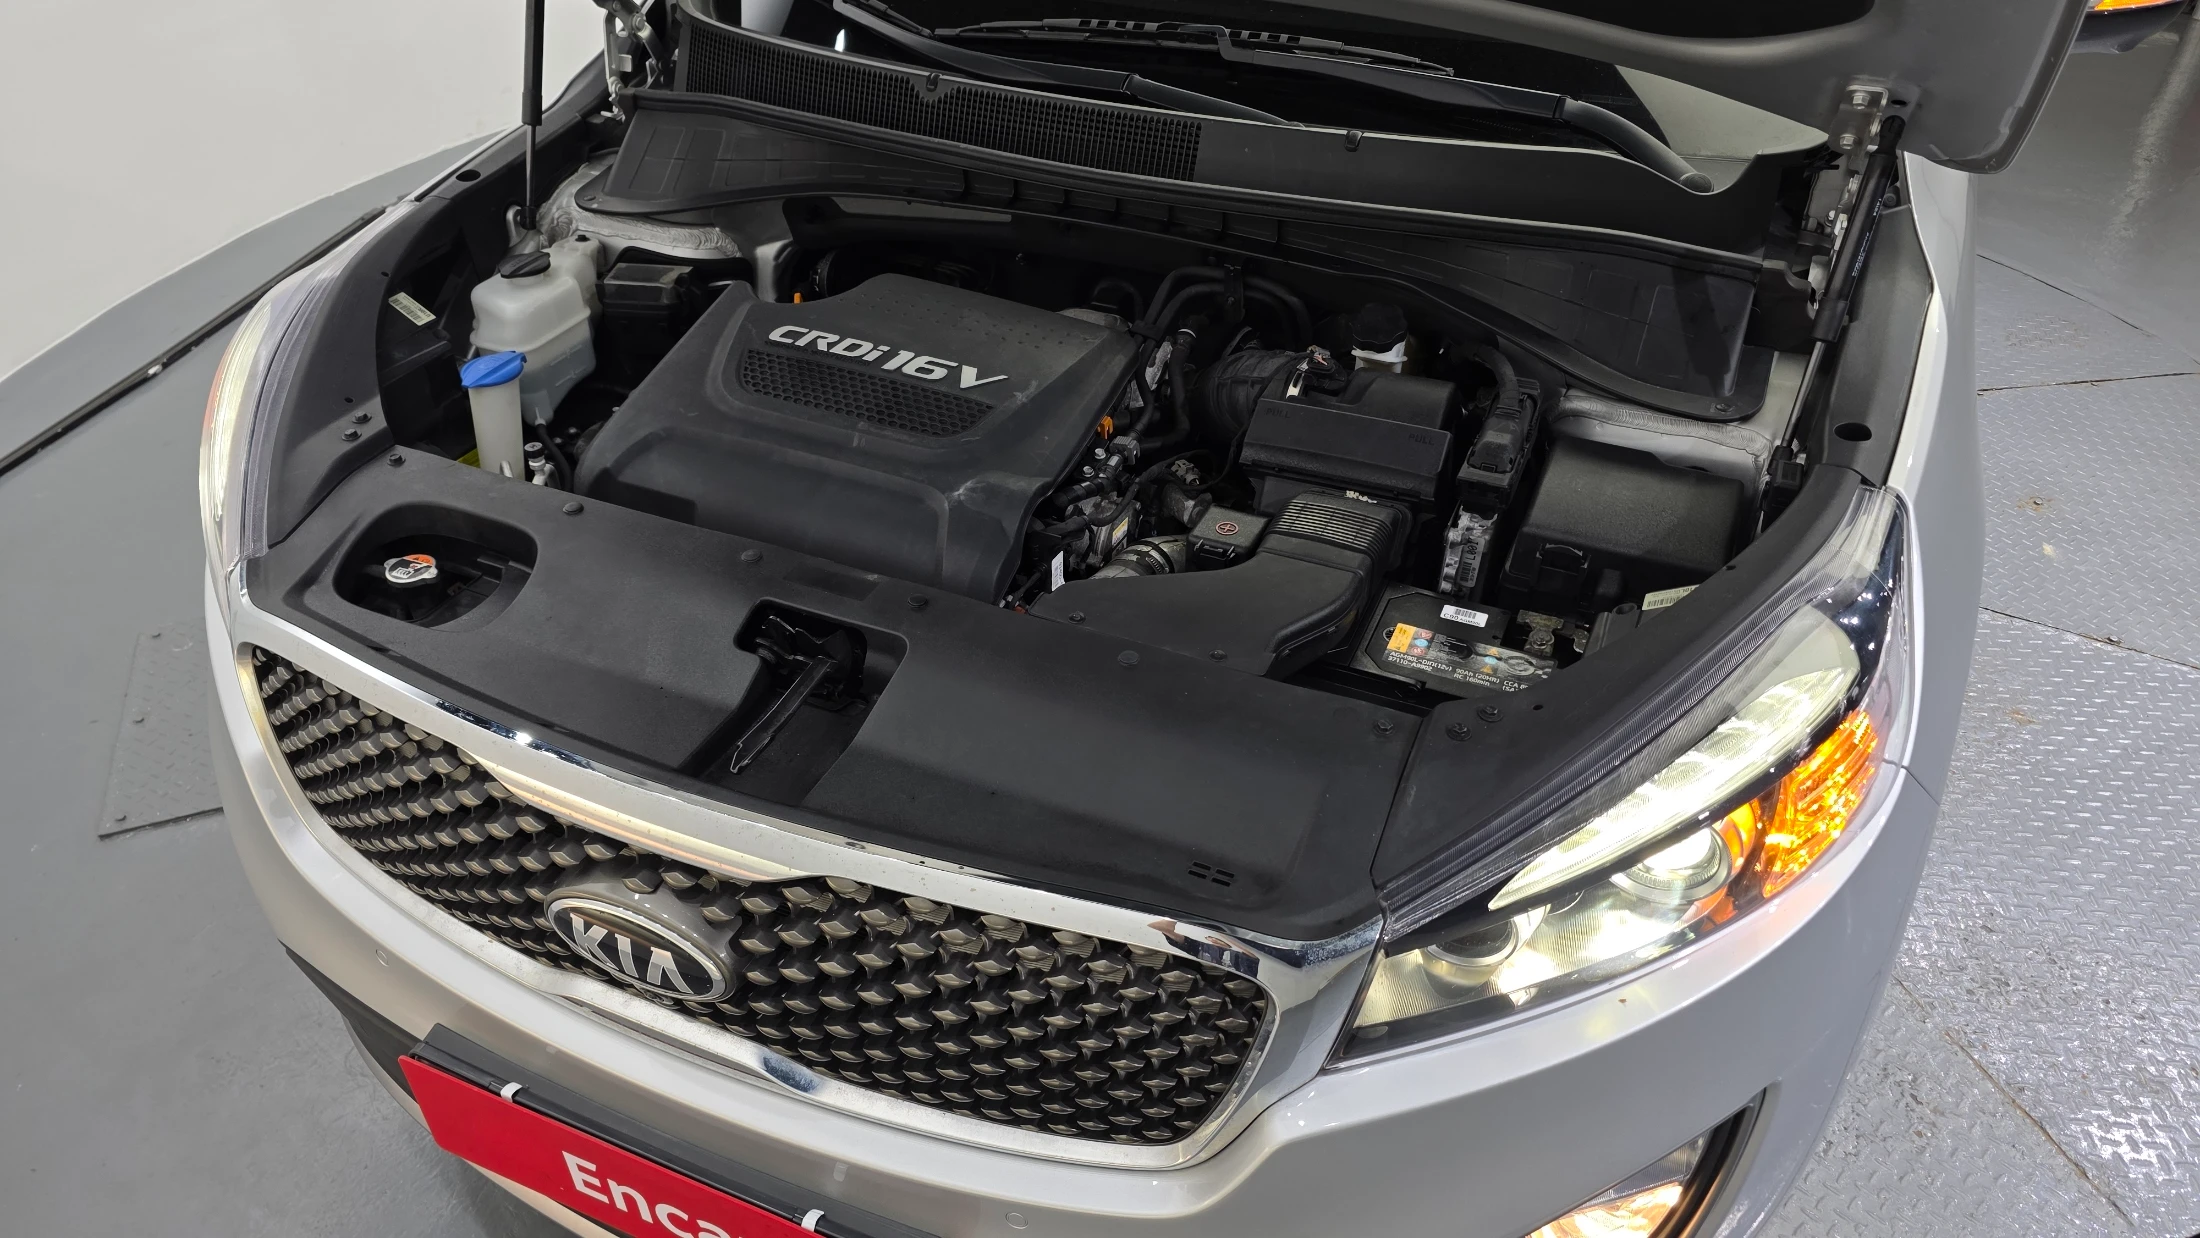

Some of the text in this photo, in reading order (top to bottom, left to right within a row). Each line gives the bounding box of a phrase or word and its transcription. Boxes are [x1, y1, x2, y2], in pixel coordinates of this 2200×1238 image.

[1266, 407, 1291, 419] PULL
[1409, 433, 1435, 446] PULL
[1503, 680, 1519, 689] CCA
[569, 912, 694, 995] KIA
